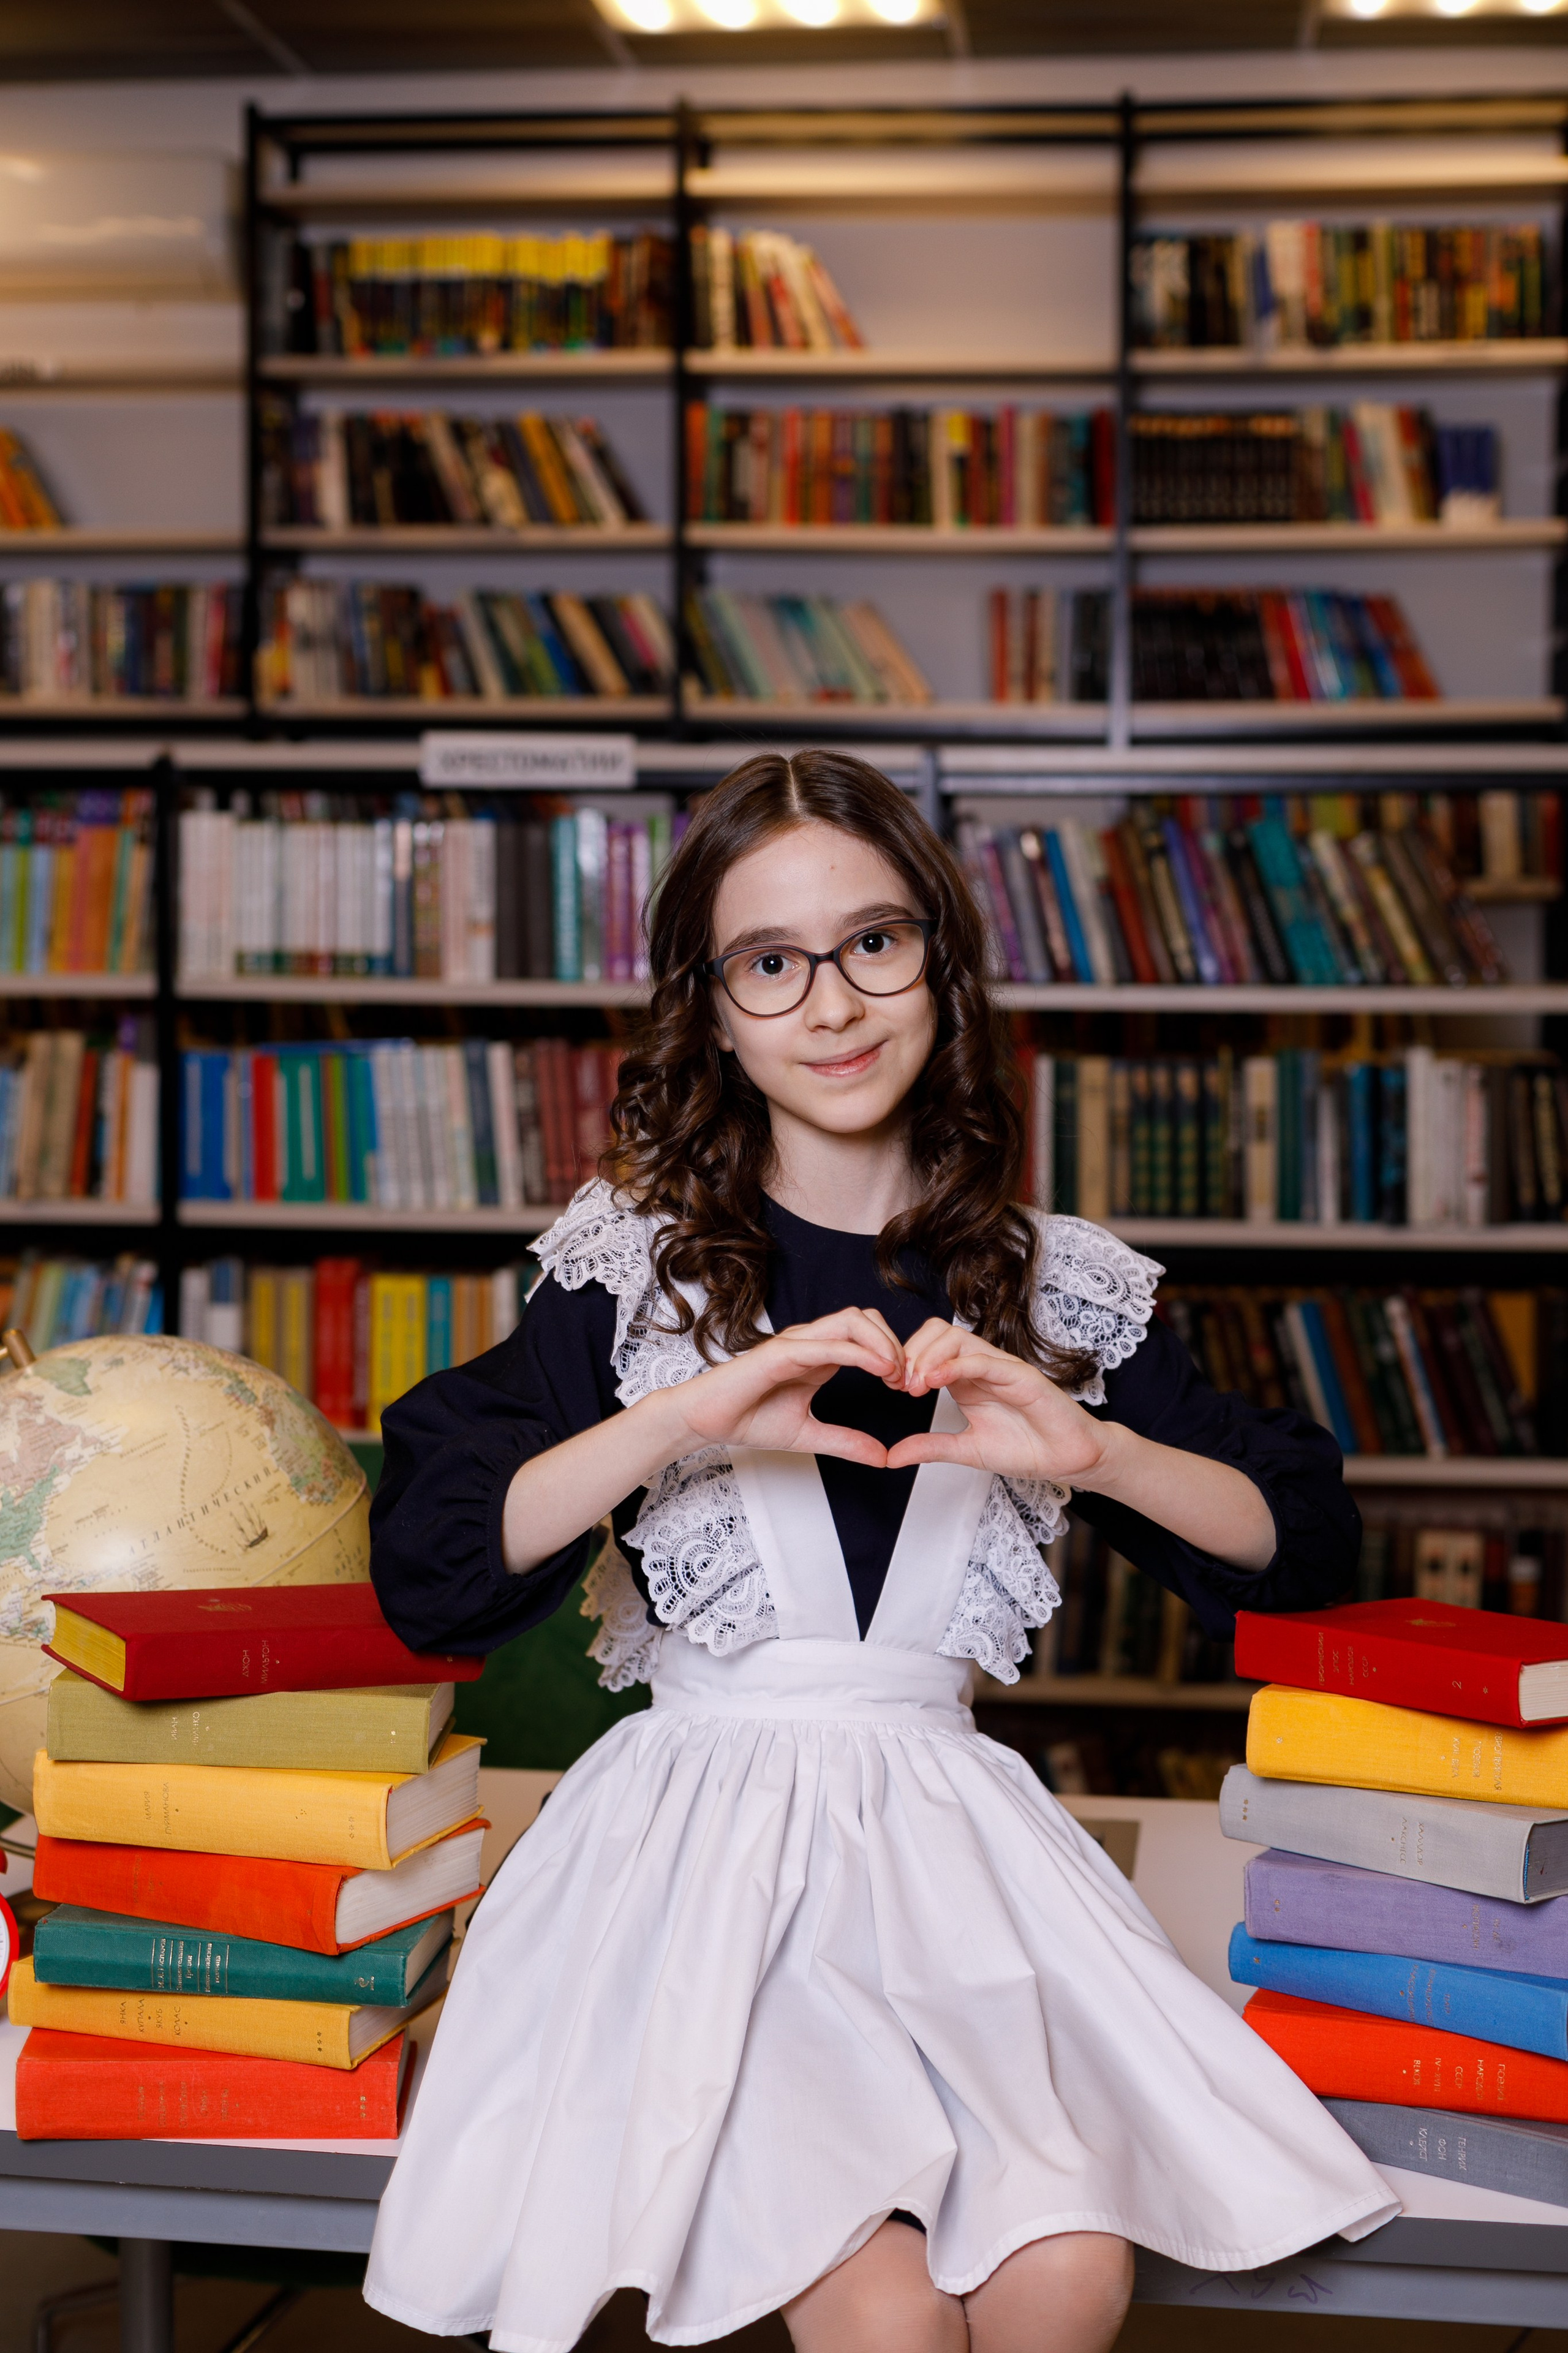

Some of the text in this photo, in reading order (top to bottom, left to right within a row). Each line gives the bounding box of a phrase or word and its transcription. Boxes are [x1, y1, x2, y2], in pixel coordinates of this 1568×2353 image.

[260, 1640, 270, 1684] МИЛЬТОН
[1452, 1680, 1461, 1690] 2
[1454, 2066, 1463, 2089] СССР
[1497, 2064, 1506, 2101] ПОЭЗИЯ
[1418, 2127, 1428, 2162] КЛЕЙСТ
[1438, 2138, 1447, 2161] ФОН
[1458, 2136, 1468, 2171] ГЕНРИХ
